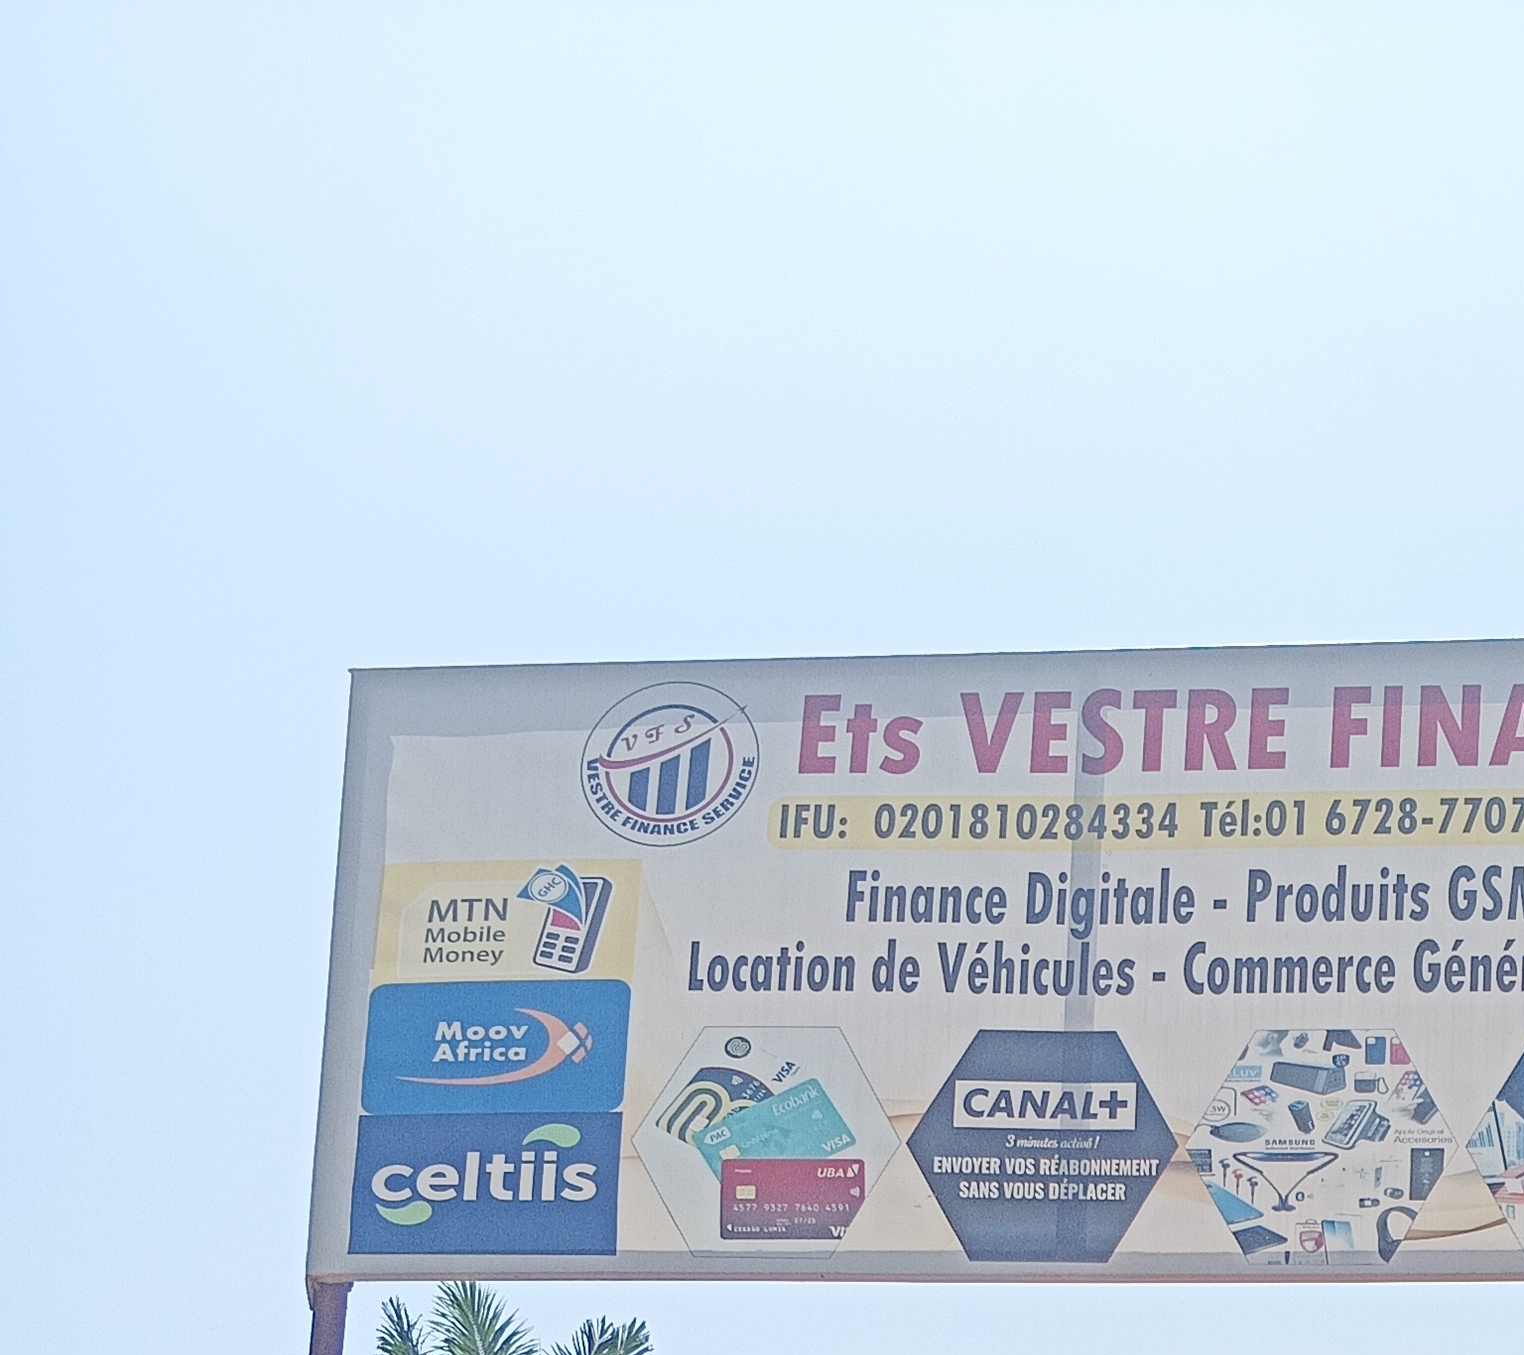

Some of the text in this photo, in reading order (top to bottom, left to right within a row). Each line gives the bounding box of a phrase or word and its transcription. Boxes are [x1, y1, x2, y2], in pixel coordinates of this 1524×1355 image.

[798, 694, 924, 775] Ets
[960, 687, 1290, 775] VESTRE
[587, 757, 755, 835] VESTRE FINANCE SERVICE
[780, 804, 848, 840] IFU:
[874, 802, 1178, 839] 0201810284334
[427, 898, 508, 923] MTN
[846, 870, 1007, 924] Finance
[1026, 868, 1195, 940] Digitale
[1246, 865, 1429, 923] Produits
[425, 926, 505, 943] Mobile
[423, 947, 504, 966] Money
[688, 941, 856, 993] Location
[872, 939, 920, 993] de
[938, 938, 1136, 996] Véhicules
[1184, 941, 1396, 994] Commerce
[434, 1021, 529, 1041] Moov
[432, 1042, 527, 1062] Africa
[771, 1061, 796, 1084] VISA
[771, 1084, 820, 1116] Ecobank
[962, 1087, 1128, 1120] CANAL+
[821, 1134, 851, 1152] VISA
[1005, 1134, 1016, 1148] 3
[372, 1151, 597, 1201] celtiis
[817, 1167, 845, 1178] UBA
[933, 1153, 1159, 1177] ENVOYER VOS RÉABONNEMENT
[959, 1178, 1126, 1201] SANS VOUS DÉPLACER
